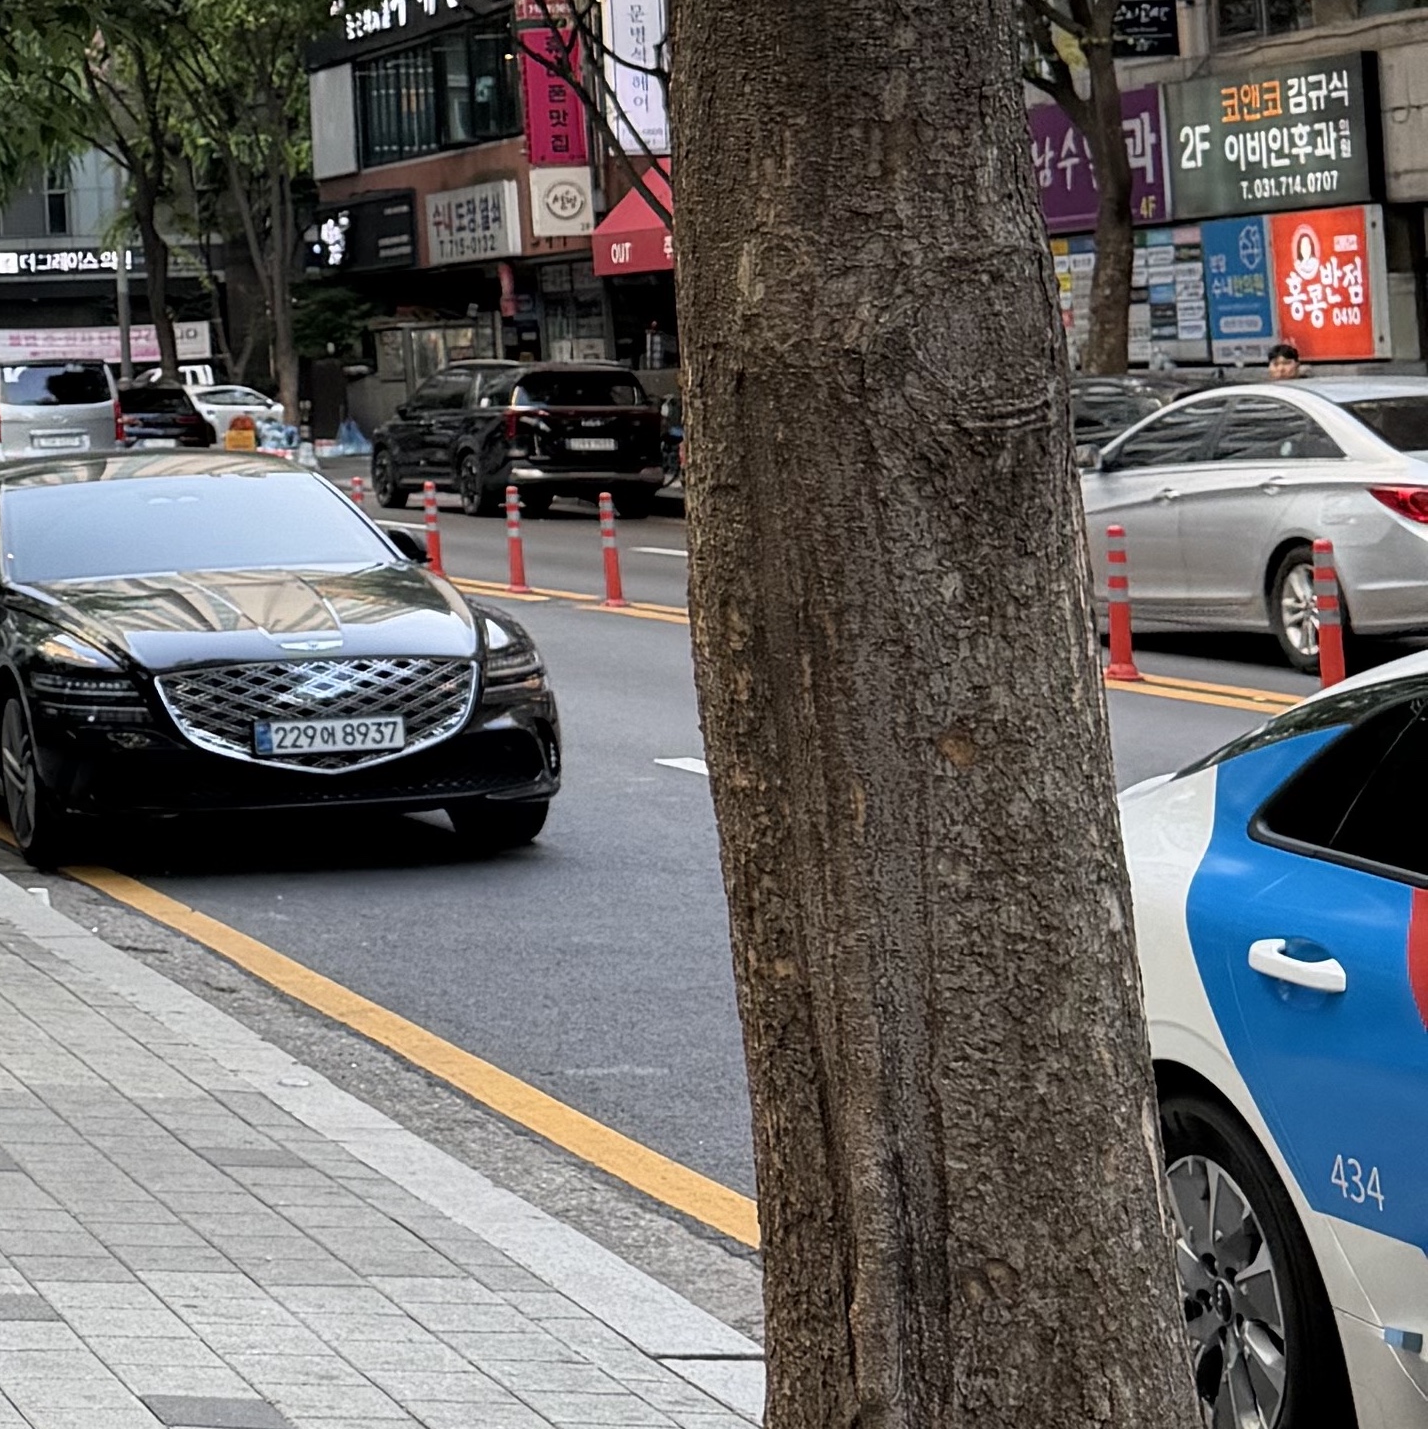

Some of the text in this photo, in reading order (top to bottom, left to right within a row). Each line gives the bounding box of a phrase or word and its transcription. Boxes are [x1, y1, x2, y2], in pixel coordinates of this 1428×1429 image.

[1220, 69, 1350, 124] 코앤코 김규식
[1179, 124, 1211, 170] 2F
[1240, 170, 1339, 201] T.031.714.0707
[610, 241, 633, 265] OUT
[1282, 254, 1365, 330] 홍콩반점
[341, 721, 399, 746] 8937
[1330, 1153, 1385, 1212] 434
